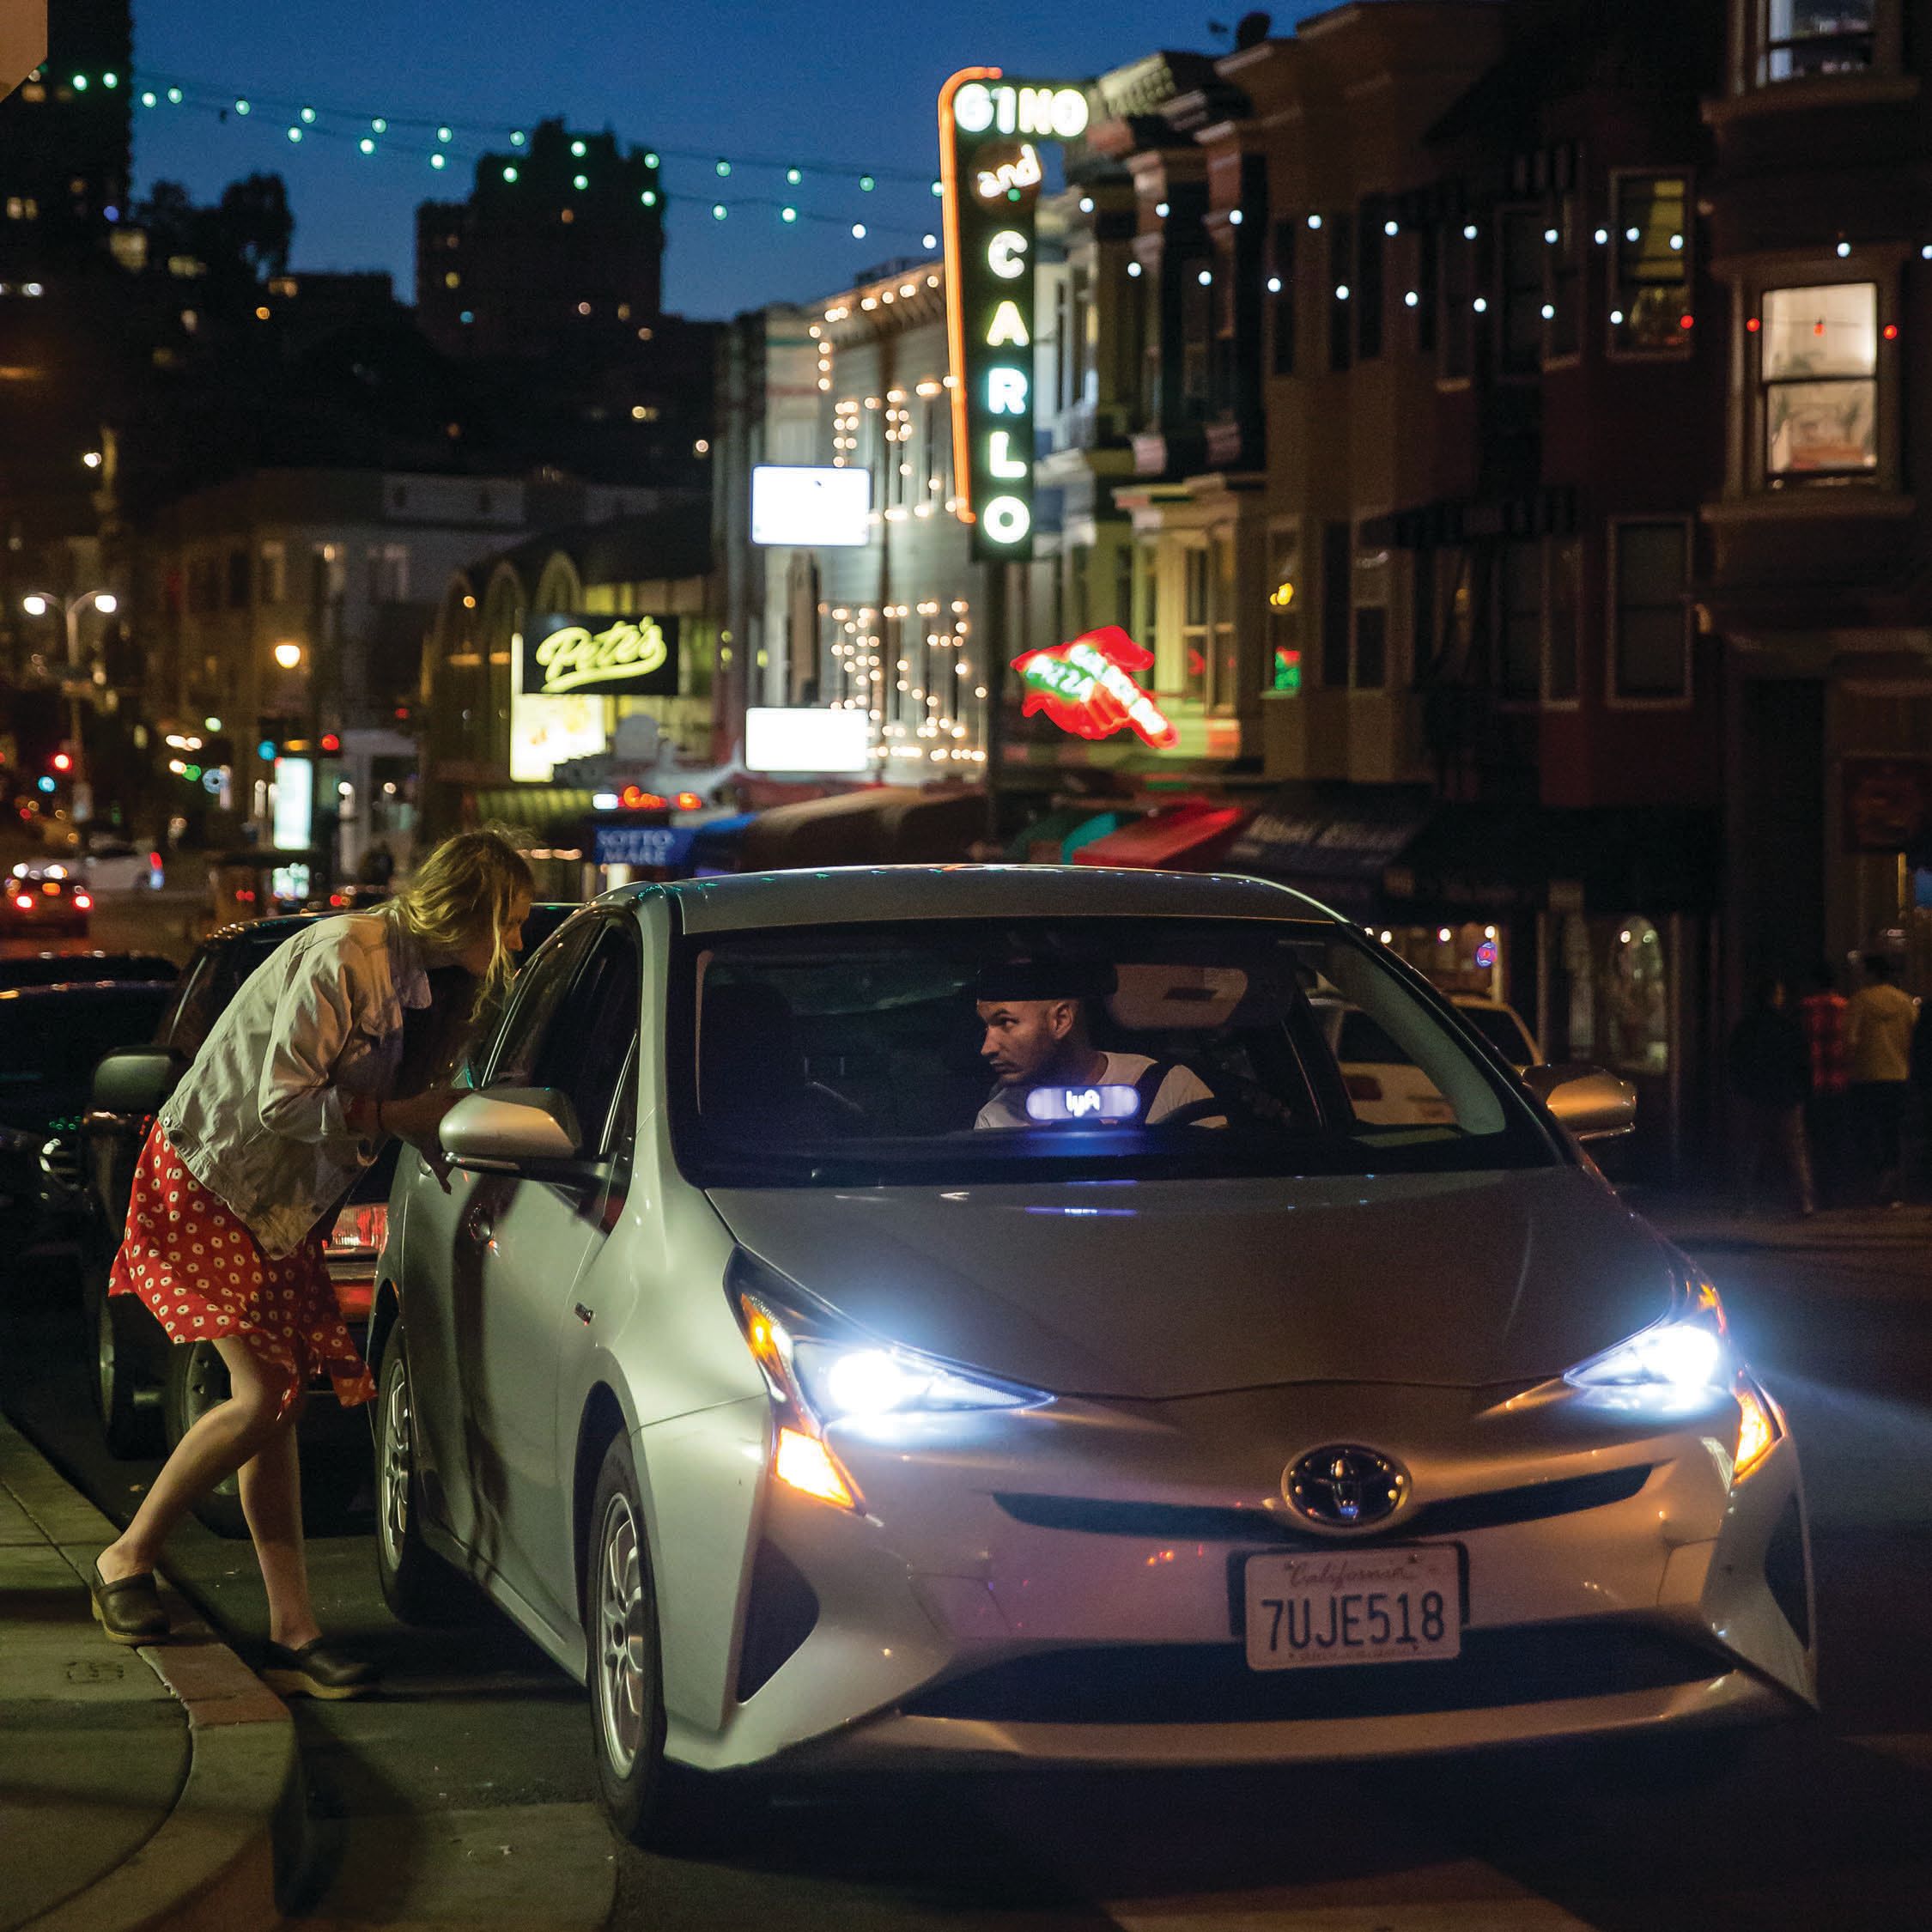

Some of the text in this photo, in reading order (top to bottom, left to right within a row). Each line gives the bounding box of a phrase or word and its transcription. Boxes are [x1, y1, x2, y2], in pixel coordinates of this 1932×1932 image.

[954, 82, 1090, 137] GINO
[977, 143, 1042, 198] and
[982, 229, 1031, 544] CARLO
[536, 616, 668, 693] Pete's
[1261, 1589, 1445, 1652] 7UJE518
